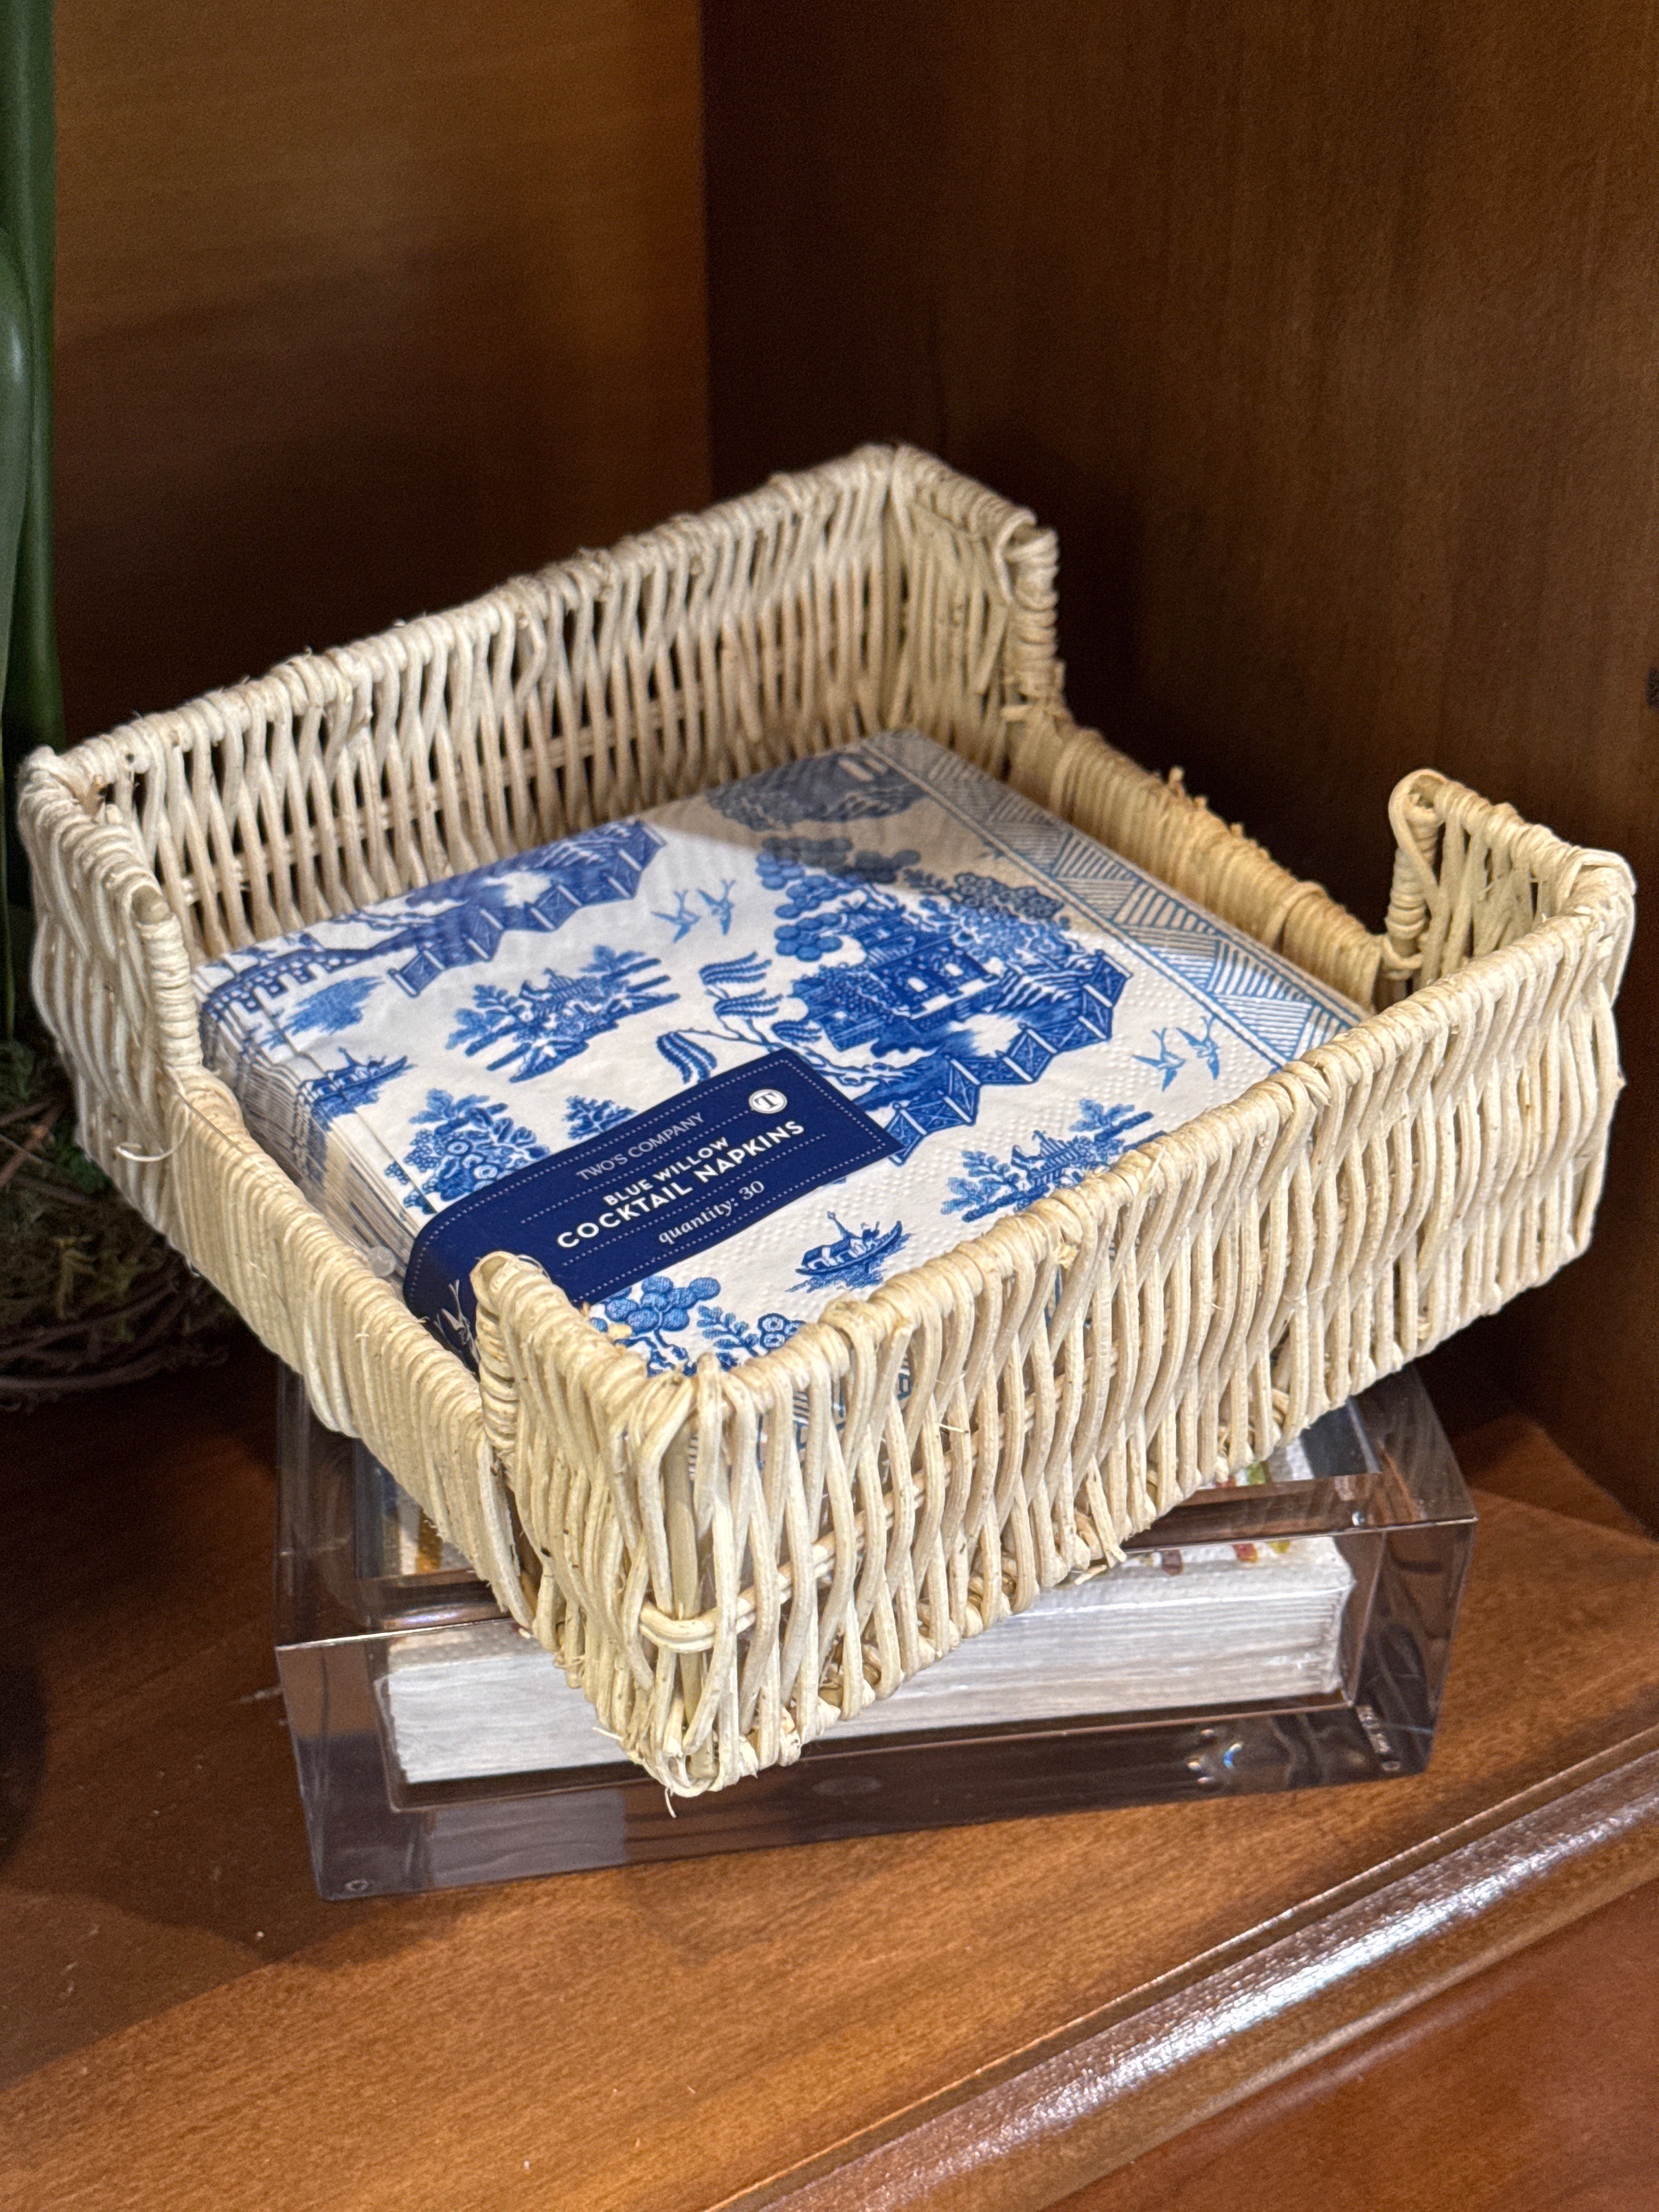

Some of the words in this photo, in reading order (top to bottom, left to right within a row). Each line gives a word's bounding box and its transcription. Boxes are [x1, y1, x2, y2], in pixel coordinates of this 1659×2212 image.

[576, 1154, 628, 1181] TWO'S
[628, 1112, 705, 1159] COMPANY
[603, 1178, 653, 1206] BLUE
[653, 1136, 729, 1182] WILLOW
[557, 1182, 693, 1249] COCKTAIL
[694, 1120, 804, 1183] NAPKINS
[658, 1198, 738, 1246] quantity:
[739, 1181, 764, 1200] 30
